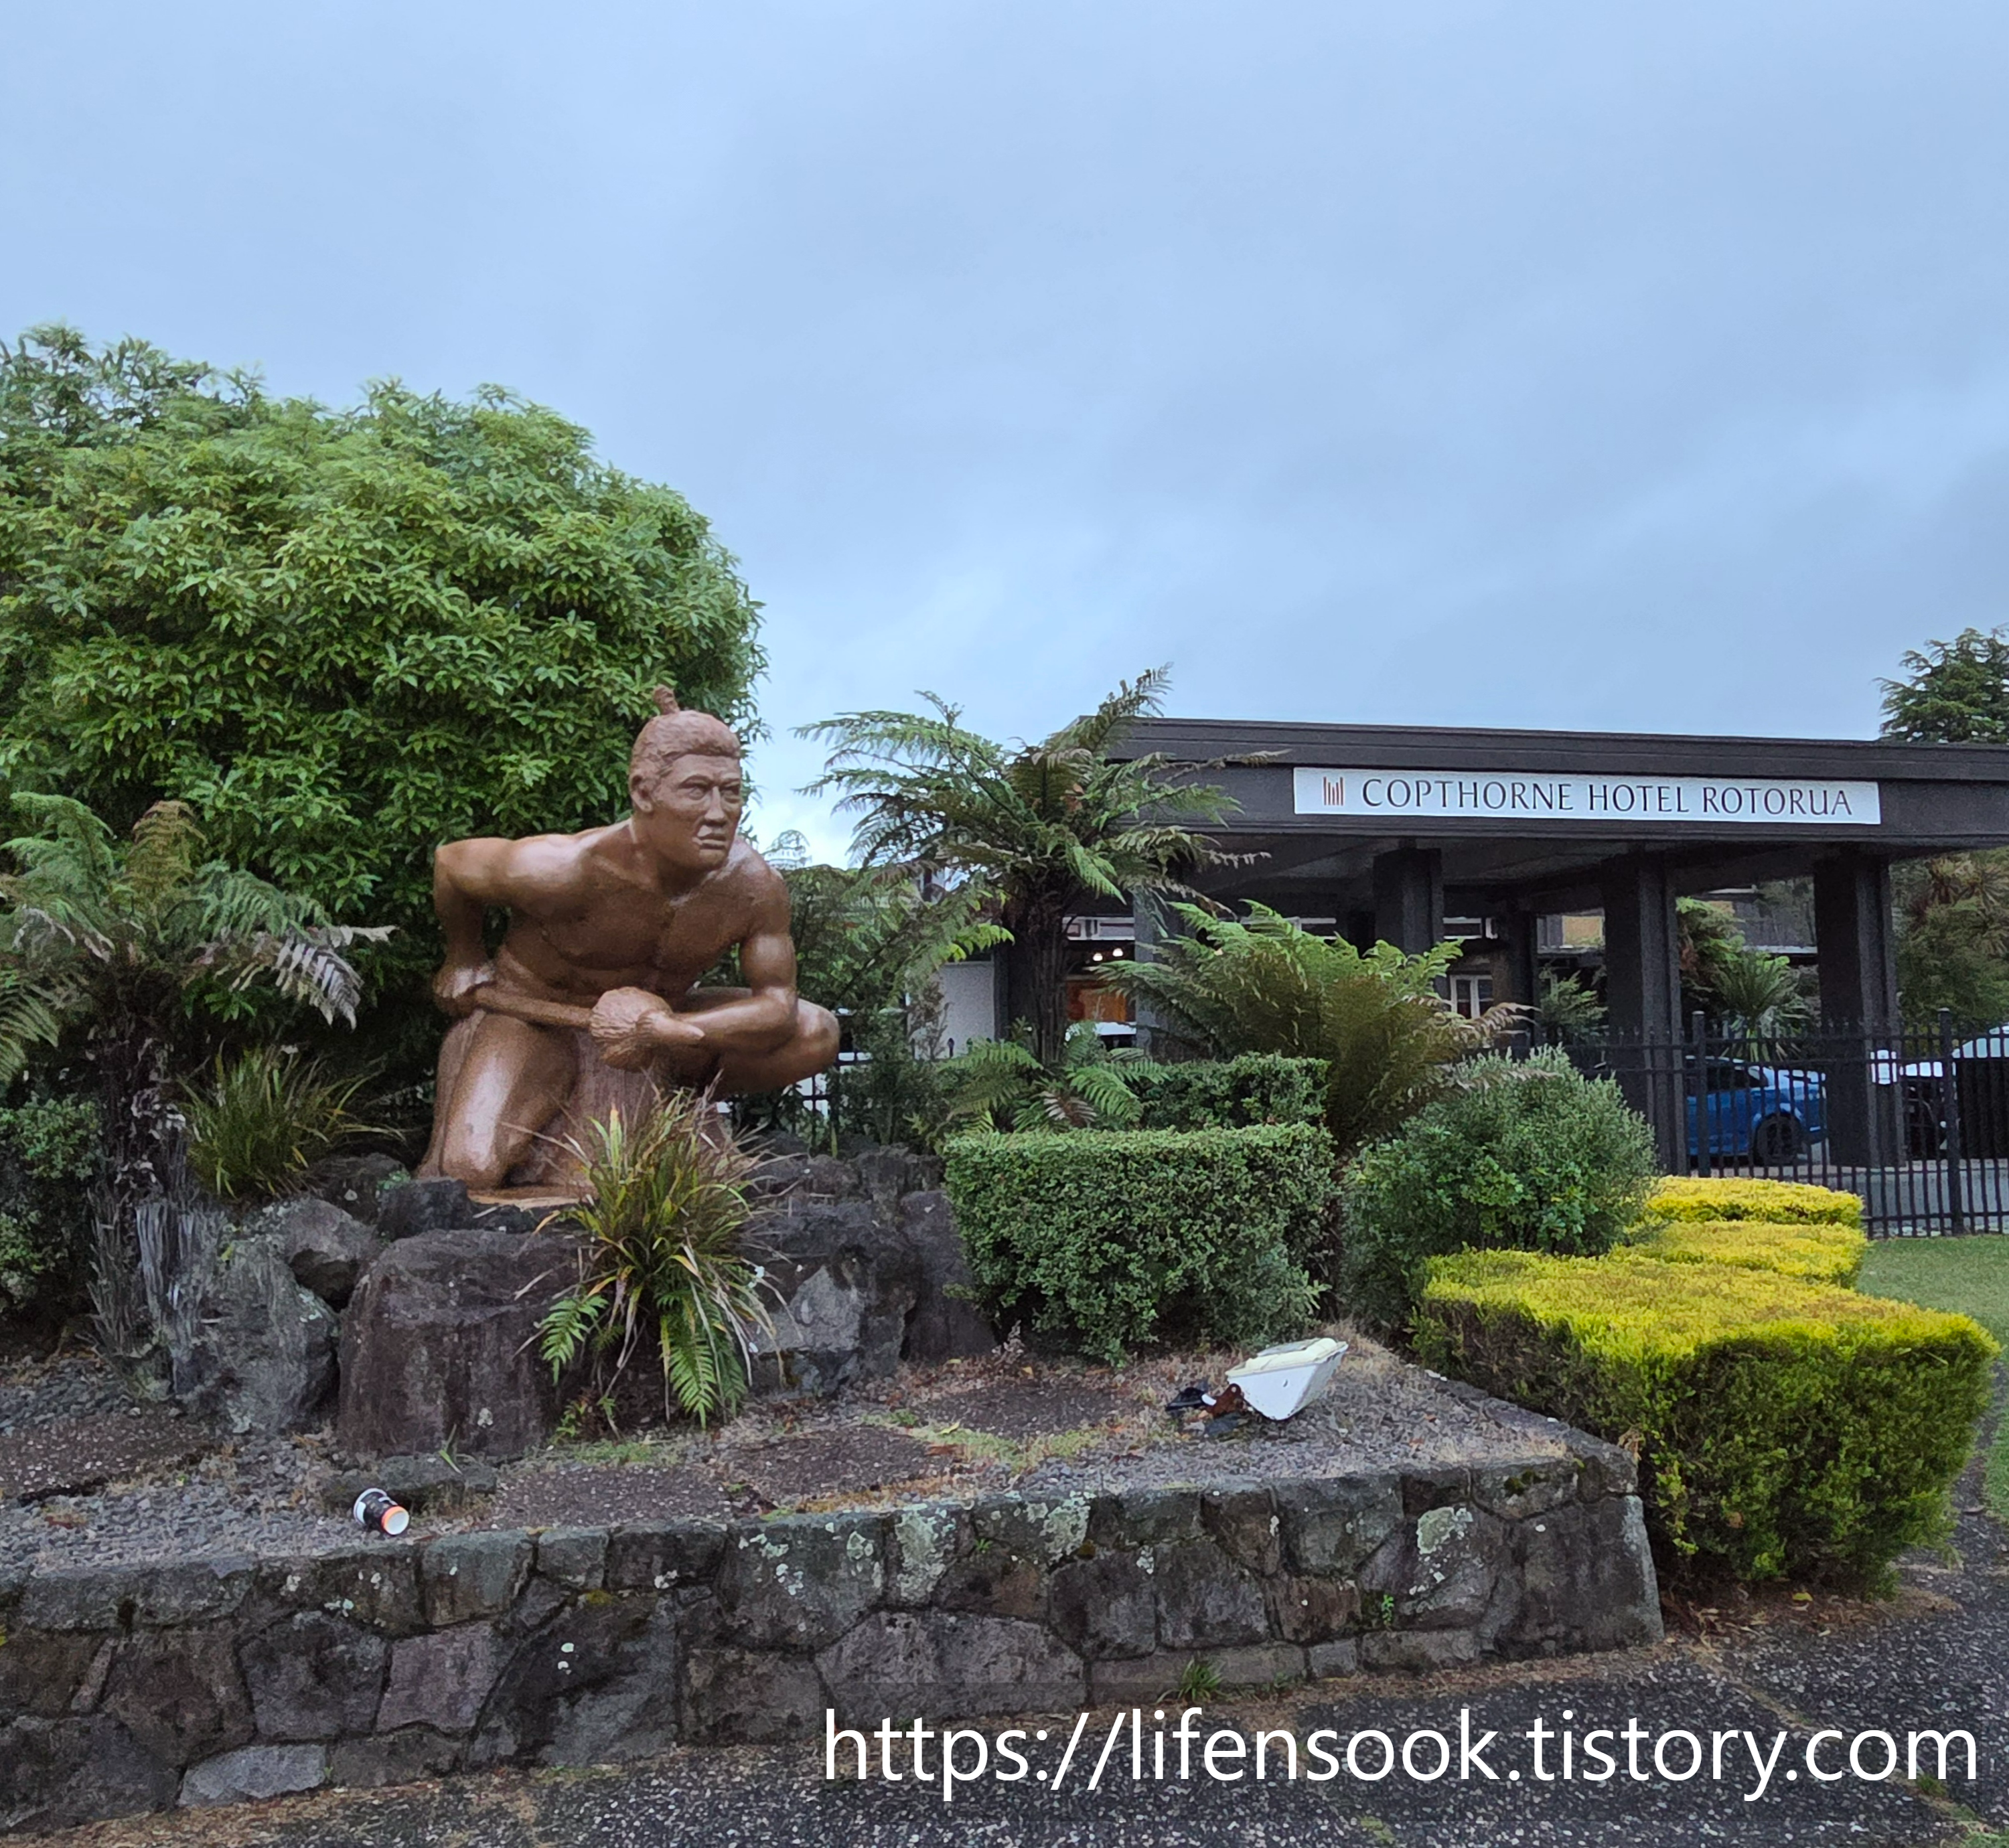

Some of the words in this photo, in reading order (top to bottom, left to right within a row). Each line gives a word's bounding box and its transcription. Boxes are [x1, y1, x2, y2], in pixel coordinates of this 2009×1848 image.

[1362, 777, 1574, 811] COPTHORNE
[1588, 783, 1690, 814] HOTEL
[1702, 785, 1852, 816] ROTORUA
